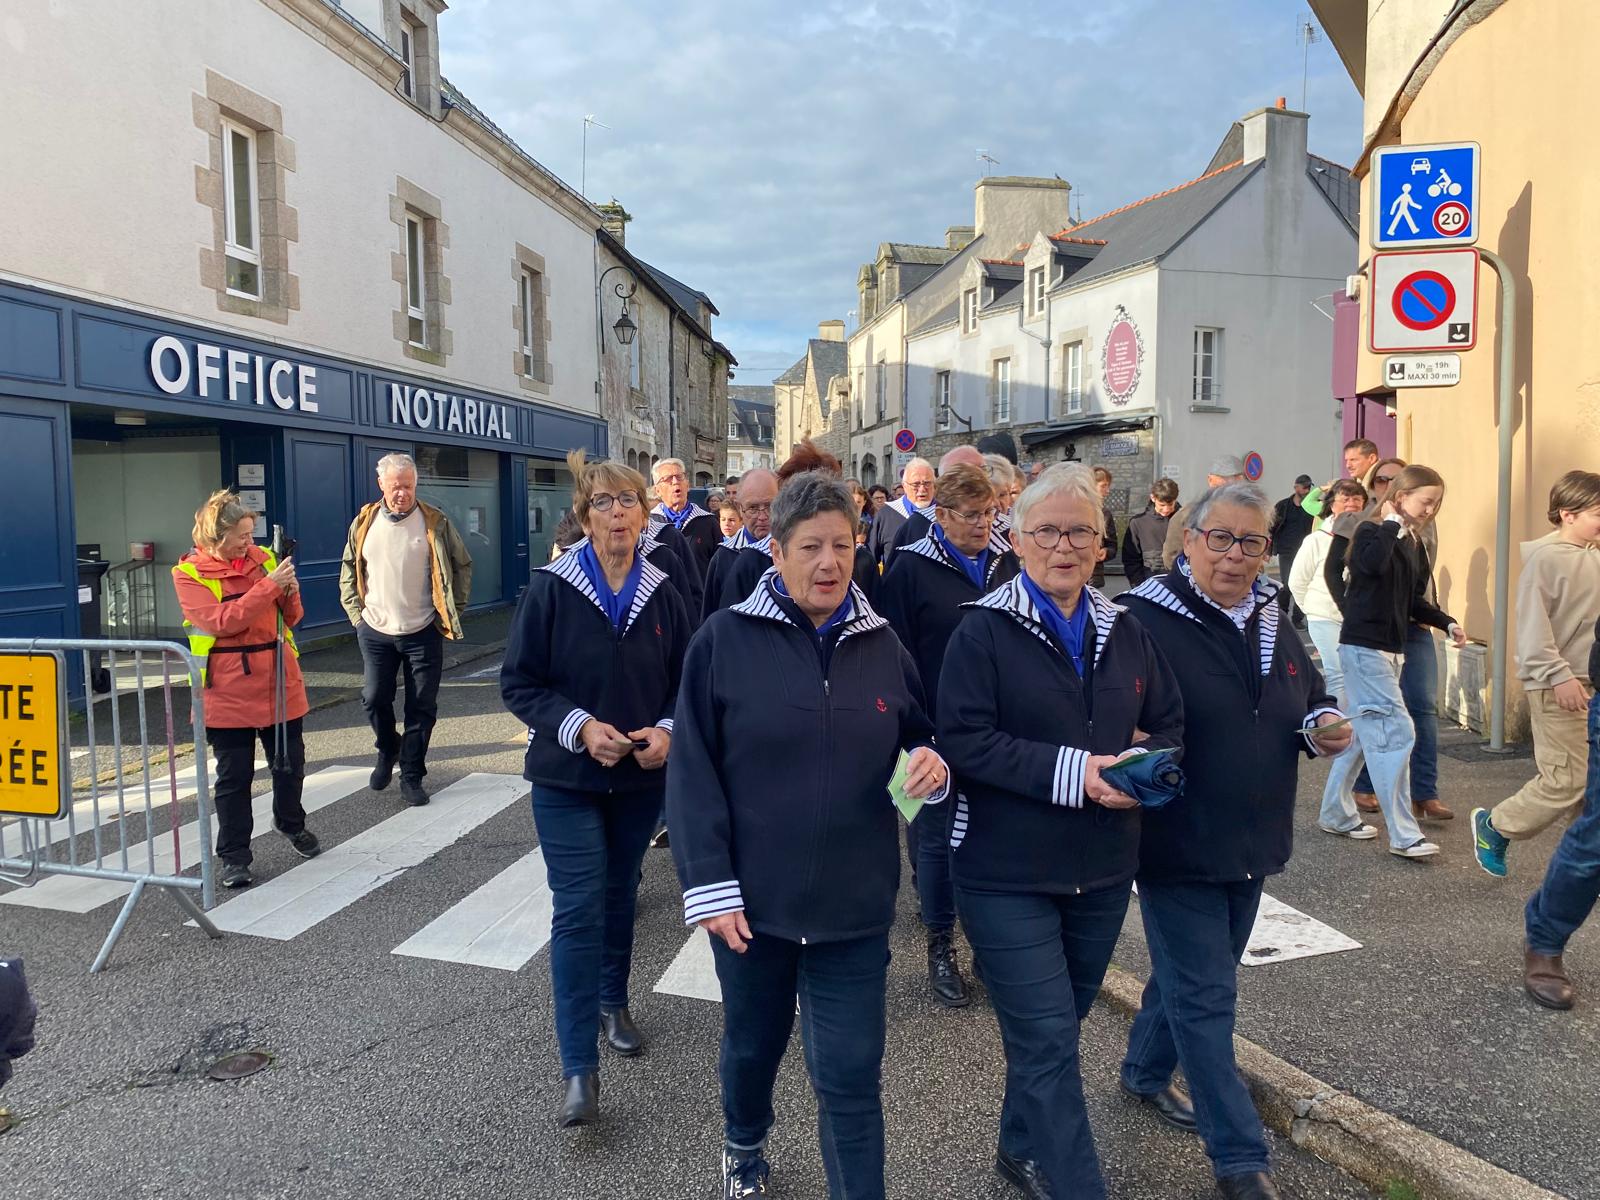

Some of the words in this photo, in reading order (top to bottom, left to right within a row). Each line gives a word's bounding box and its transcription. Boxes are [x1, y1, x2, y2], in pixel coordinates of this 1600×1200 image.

[1441, 212, 1462, 225] 20
[150, 335, 319, 413] OFFICE
[1435, 361, 1449, 369] 19h
[391, 383, 512, 440] NOTARIAL
[0, 740, 48, 785] ÉE
